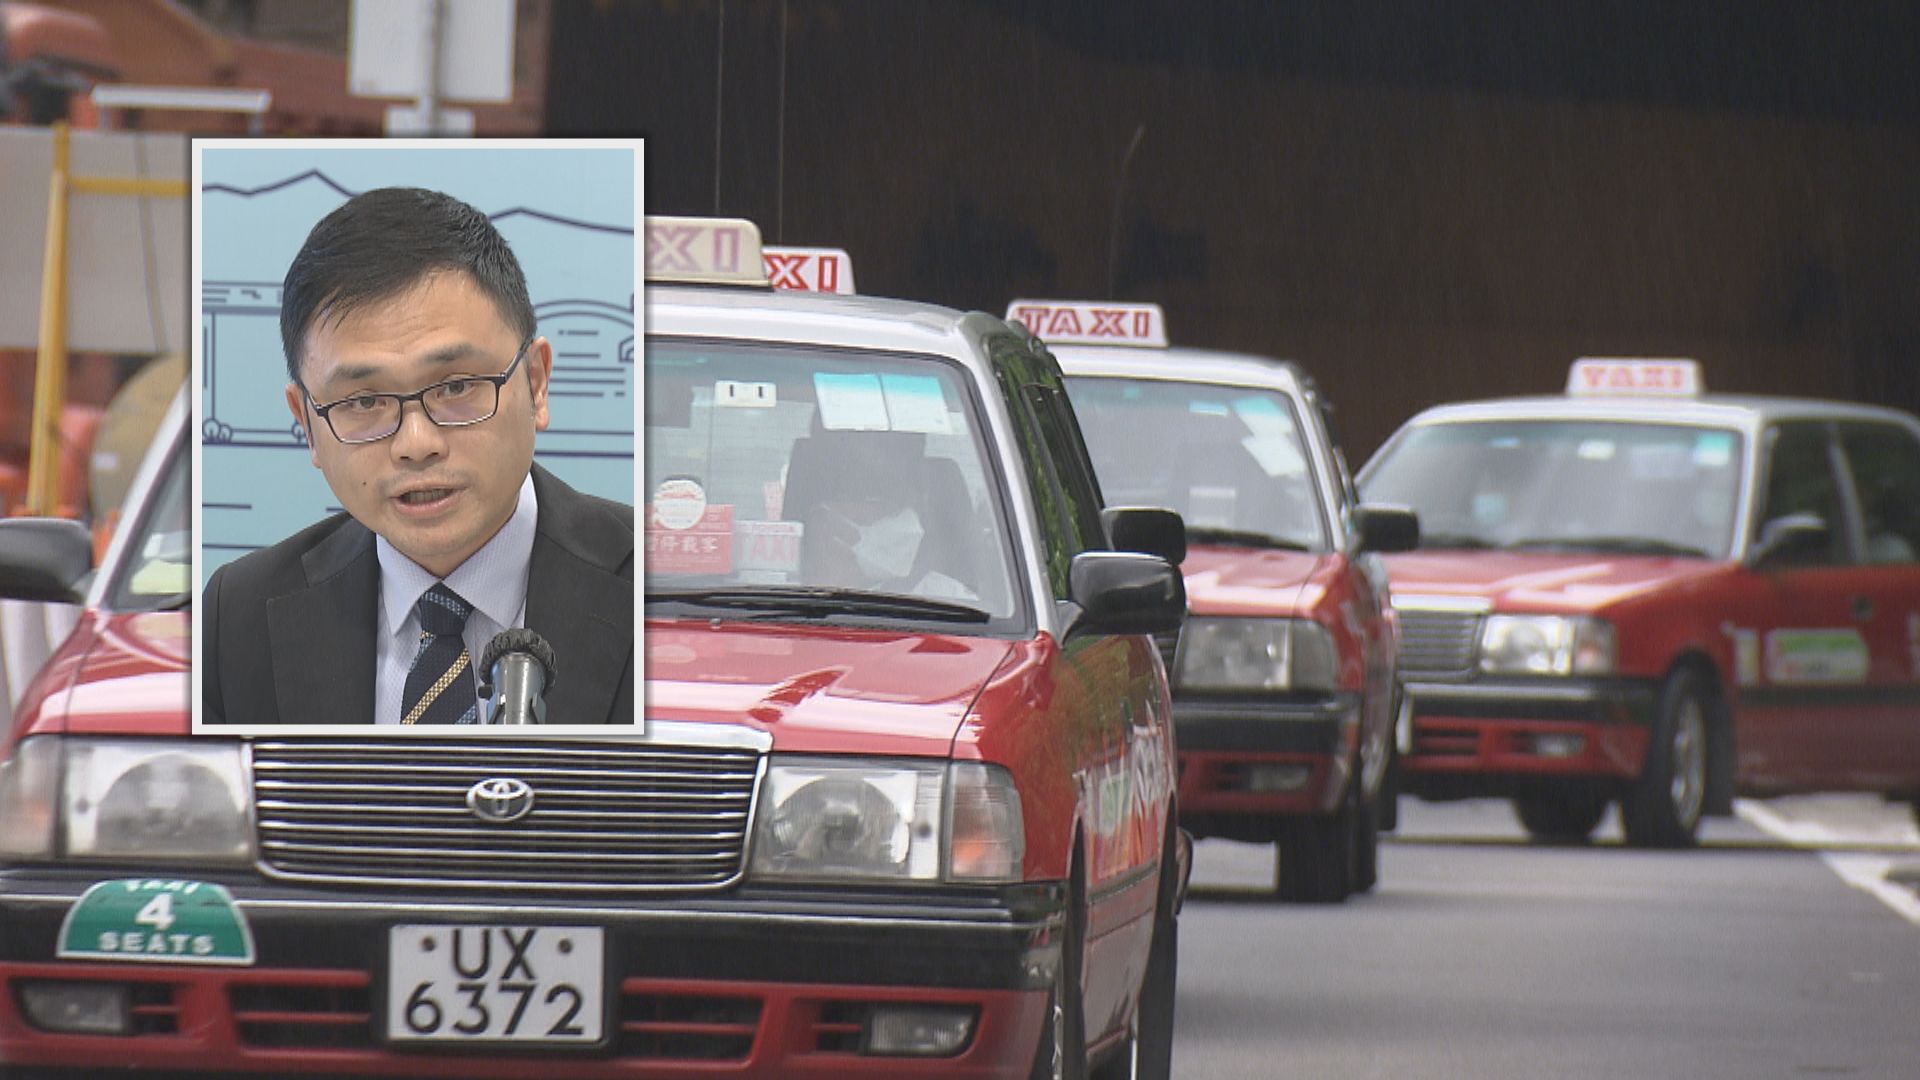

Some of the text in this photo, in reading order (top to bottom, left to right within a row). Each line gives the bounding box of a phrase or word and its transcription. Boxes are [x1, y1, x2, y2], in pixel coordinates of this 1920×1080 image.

[645, 226, 740, 273] XI
[763, 255, 838, 293] XI
[1018, 306, 1151, 338] TAXI
[1582, 366, 1684, 388] TAXI
[134, 892, 175, 930] 4
[99, 932, 214, 955] SEATS
[453, 928, 537, 980] UX
[405, 981, 584, 1035] 6372
